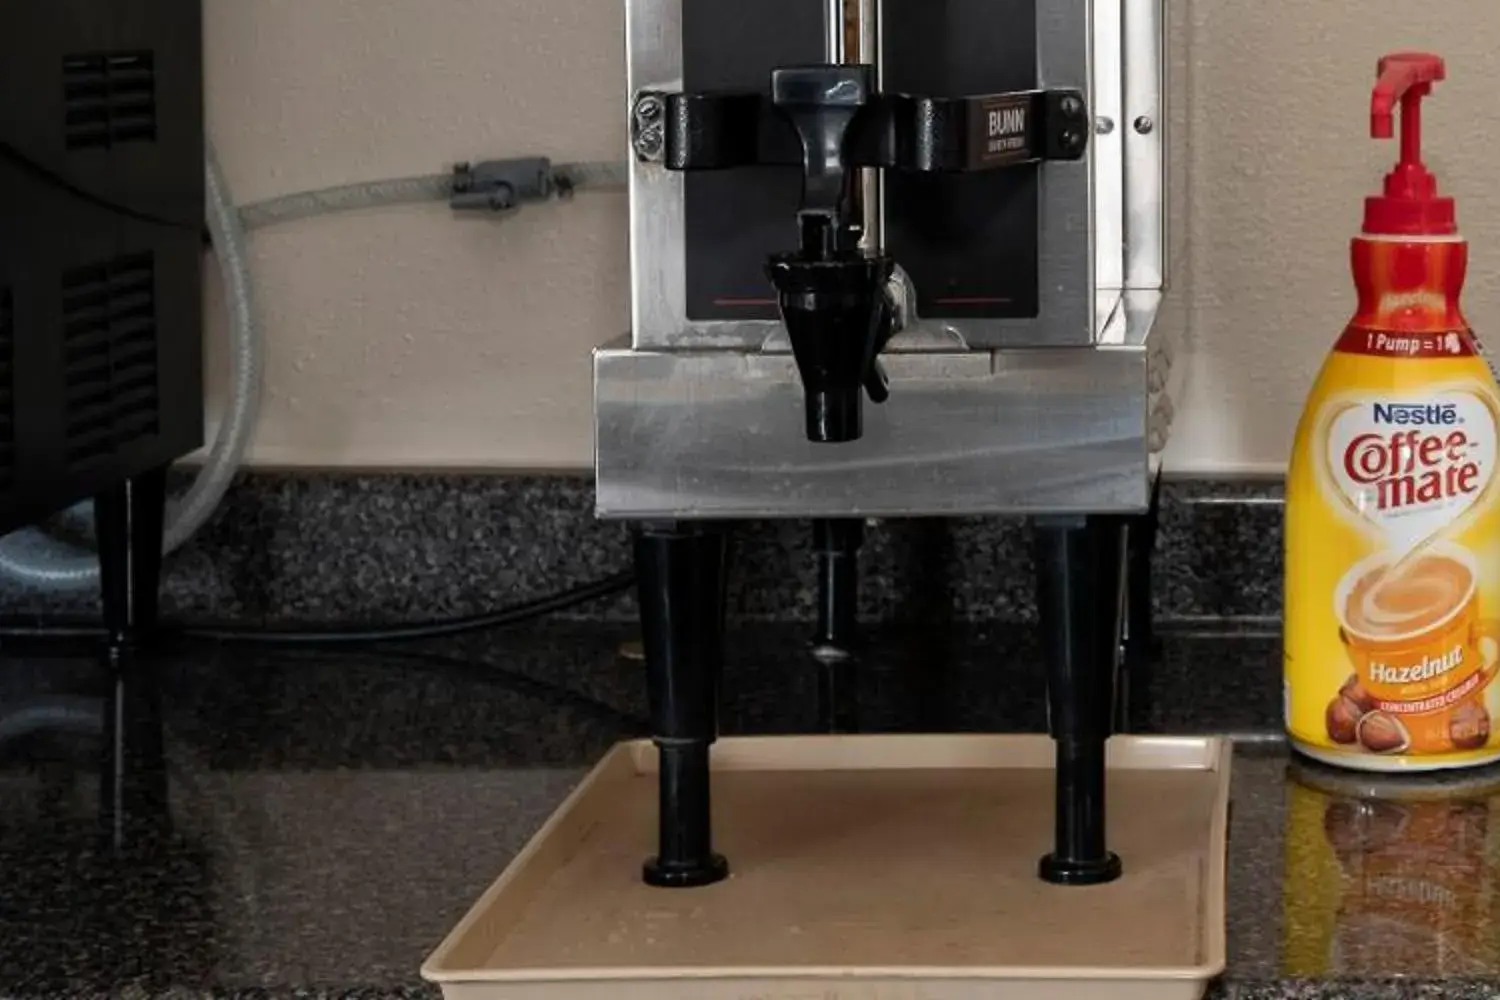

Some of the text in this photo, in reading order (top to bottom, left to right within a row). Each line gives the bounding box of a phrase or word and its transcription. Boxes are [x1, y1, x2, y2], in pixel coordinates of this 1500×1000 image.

[989, 108, 1025, 136] BUNN
[1376, 333, 1421, 355] Pump
[1377, 461, 1478, 510] mate
[1369, 645, 1463, 684] Hazelnut
